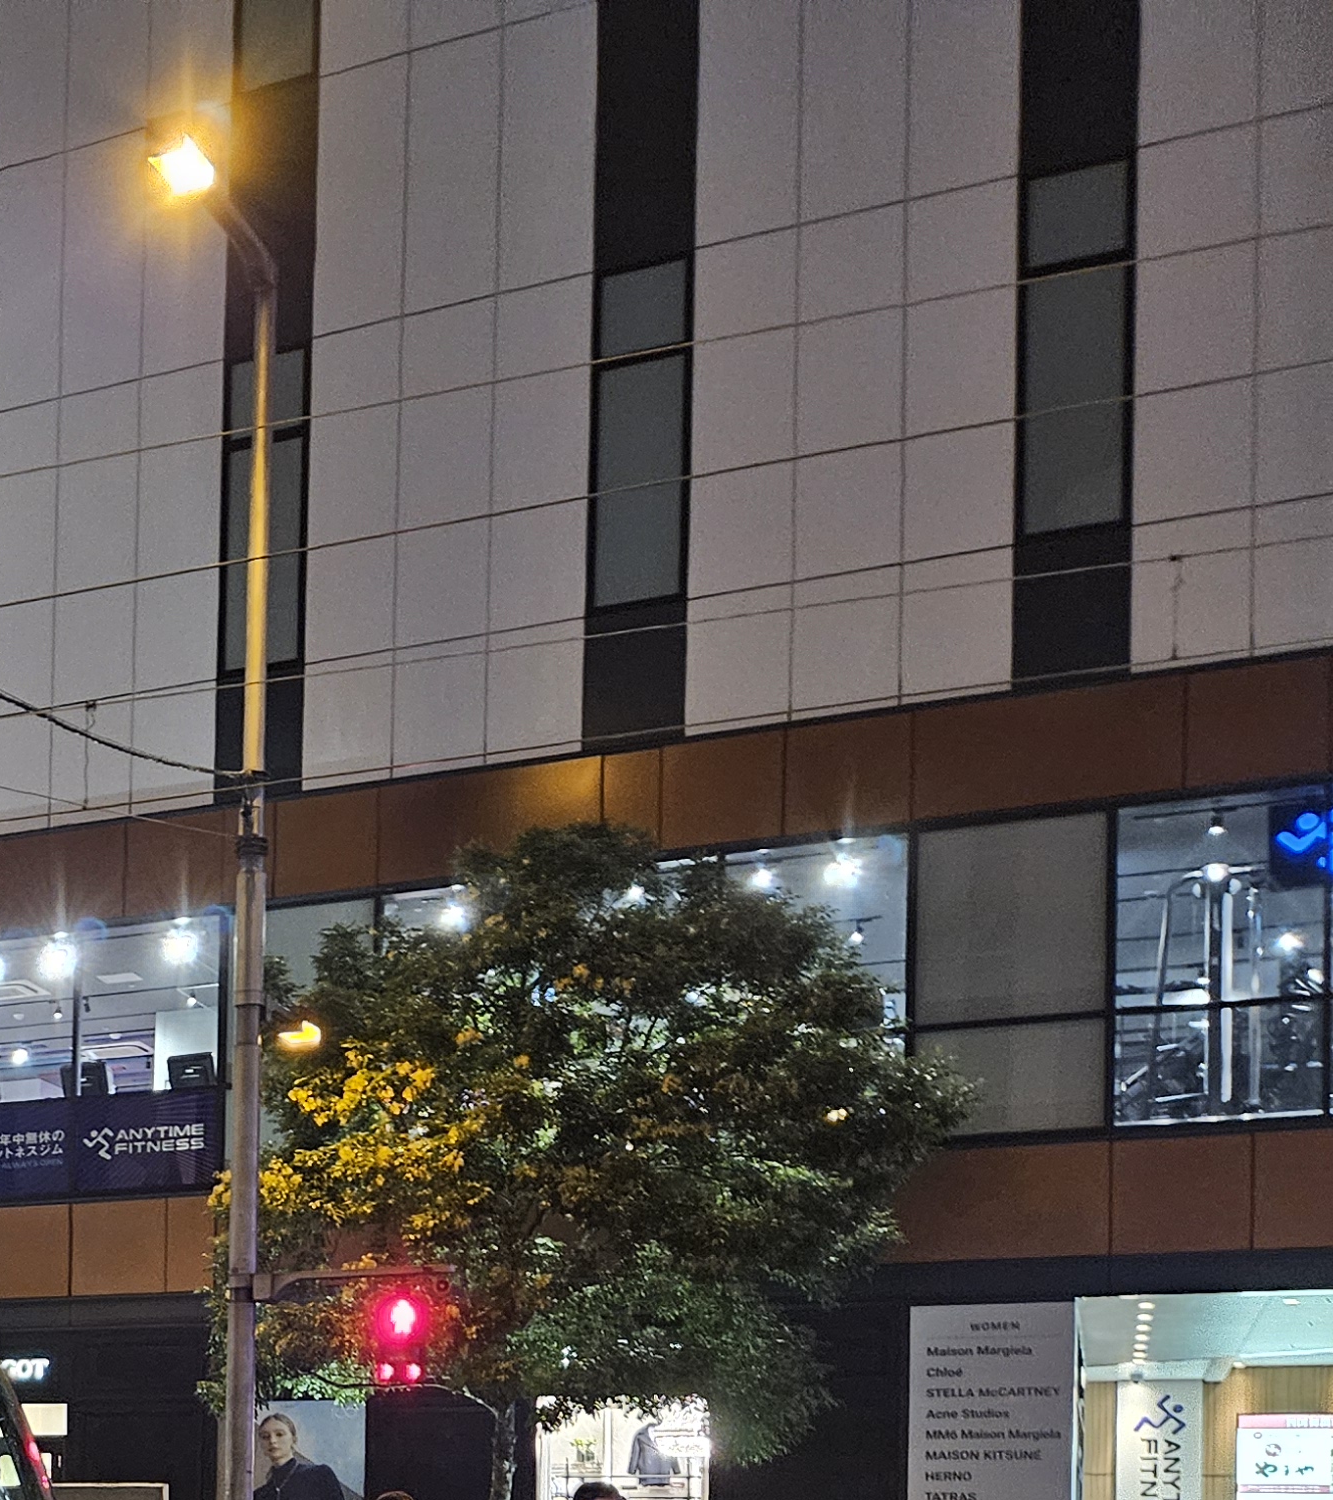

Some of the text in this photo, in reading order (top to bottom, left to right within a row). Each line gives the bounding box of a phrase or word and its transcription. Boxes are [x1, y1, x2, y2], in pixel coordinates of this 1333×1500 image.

[115, 1123, 204, 1141] ANYTIME
[114, 1138, 205, 1155] FITNESS
[970, 1321, 1021, 1332] WOMEN
[926, 1345, 1033, 1358] Maison Margiela
[926, 1366, 963, 1378] Chloé
[926, 1385, 1061, 1398] STELLA McCARTNEY
[925, 1408, 1010, 1419] Acne Studios
[925, 1428, 1062, 1441] MM6 Maison Margiela
[925, 1450, 980, 1461] MAISON
[925, 1471, 972, 1482] HERNO
